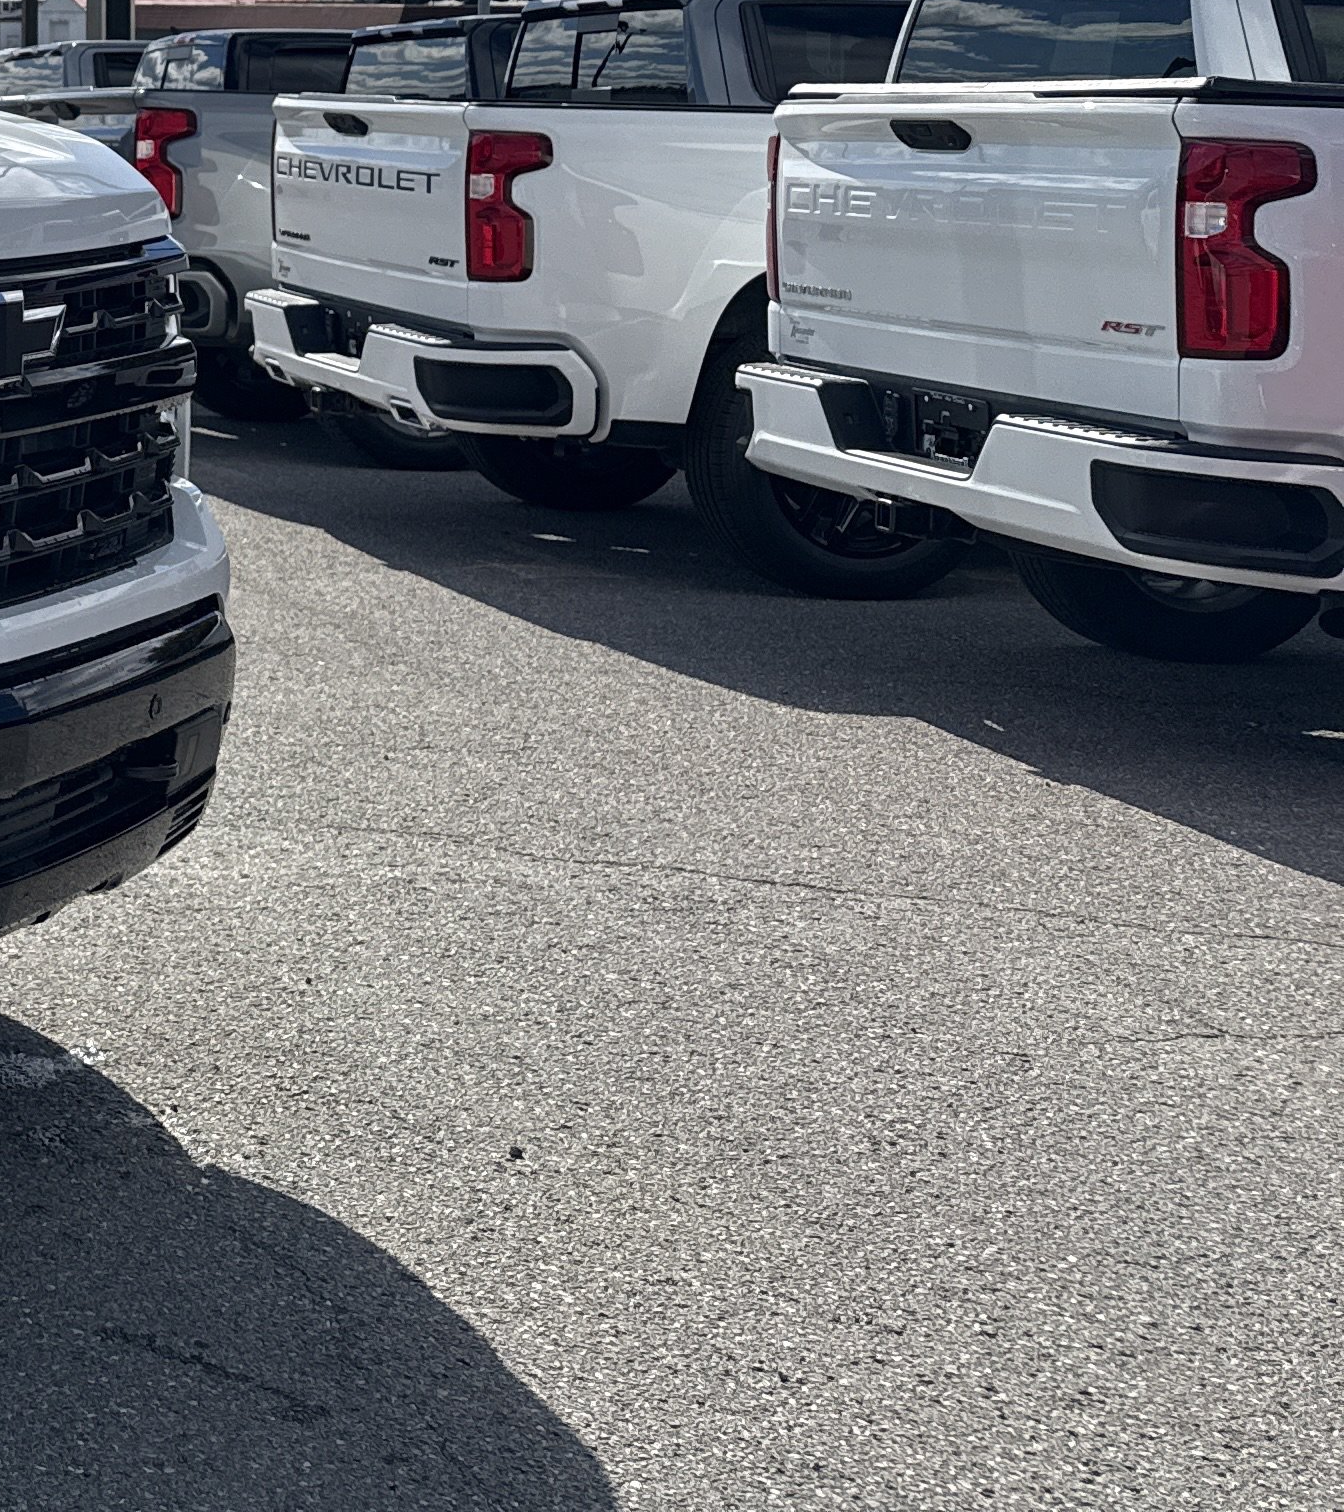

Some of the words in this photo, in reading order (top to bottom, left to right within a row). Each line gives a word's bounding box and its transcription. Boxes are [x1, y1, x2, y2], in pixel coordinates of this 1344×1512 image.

[276, 156, 441, 194] CHEVROLET
[786, 183, 1129, 234] CHEVROLET
[428, 256, 460, 268] RST
[1101, 320, 1166, 337] RST
